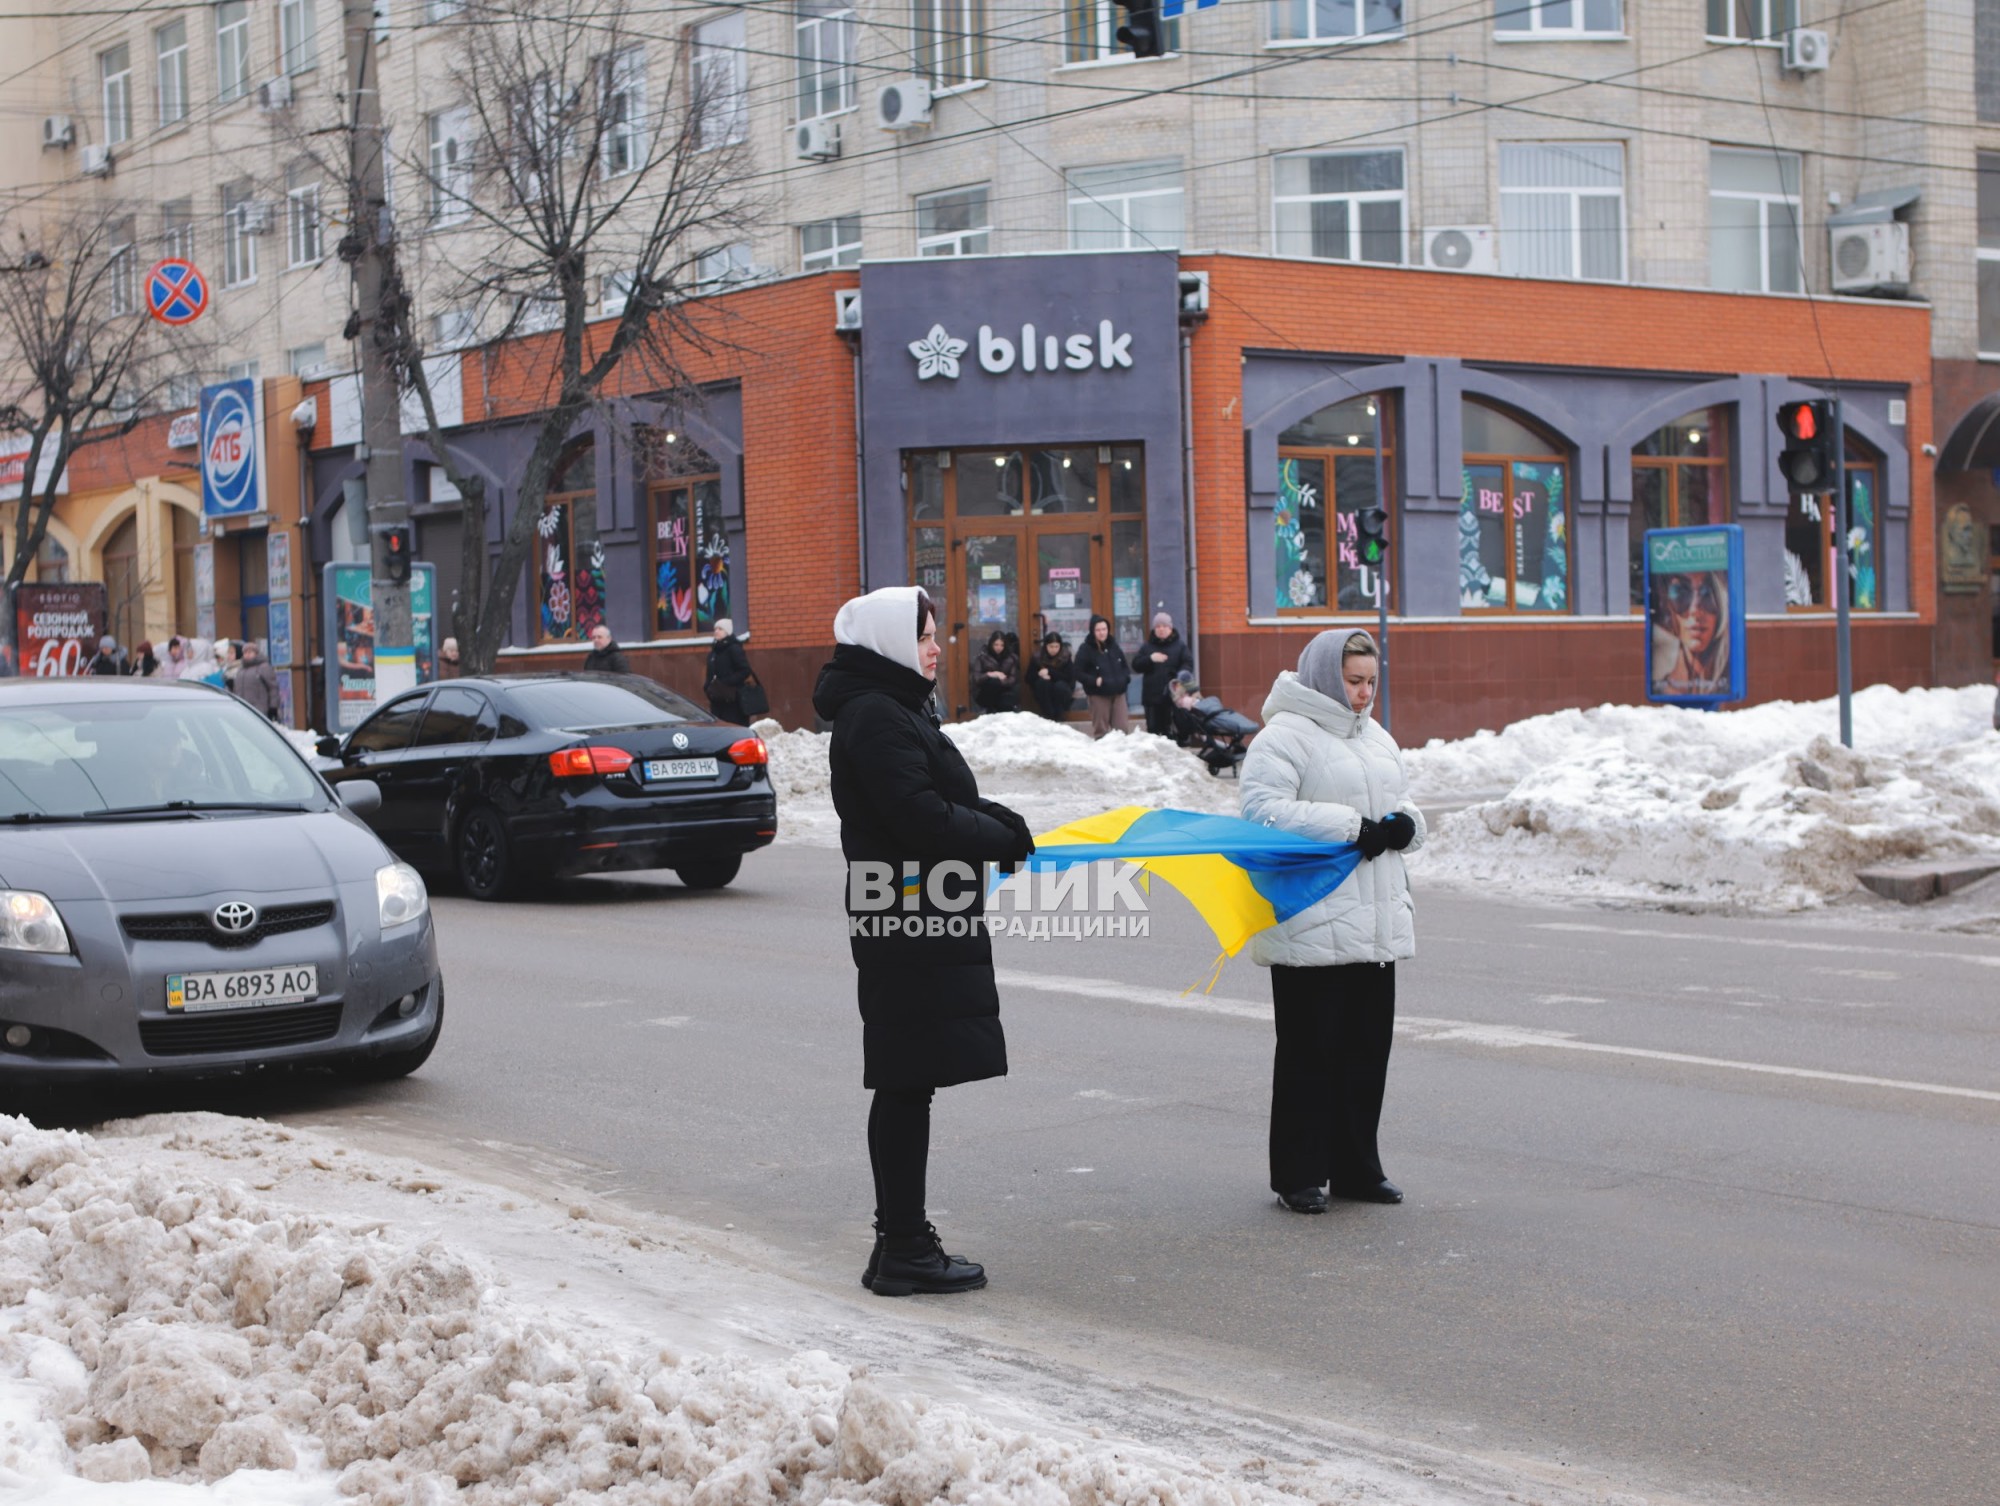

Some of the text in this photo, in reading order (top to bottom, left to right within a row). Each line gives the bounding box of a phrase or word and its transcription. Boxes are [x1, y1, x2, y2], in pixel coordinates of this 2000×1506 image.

[978, 319, 1133, 374] blisk
[210, 432, 241, 462] АТБ
[1479, 489, 1535, 518] BEST
[33, 609, 88, 625] СЕЗОННИЙ
[27, 625, 95, 639] РОЗПРОДАЖ
[671, 763, 696, 774] 8928
[224, 973, 275, 998] 6893
